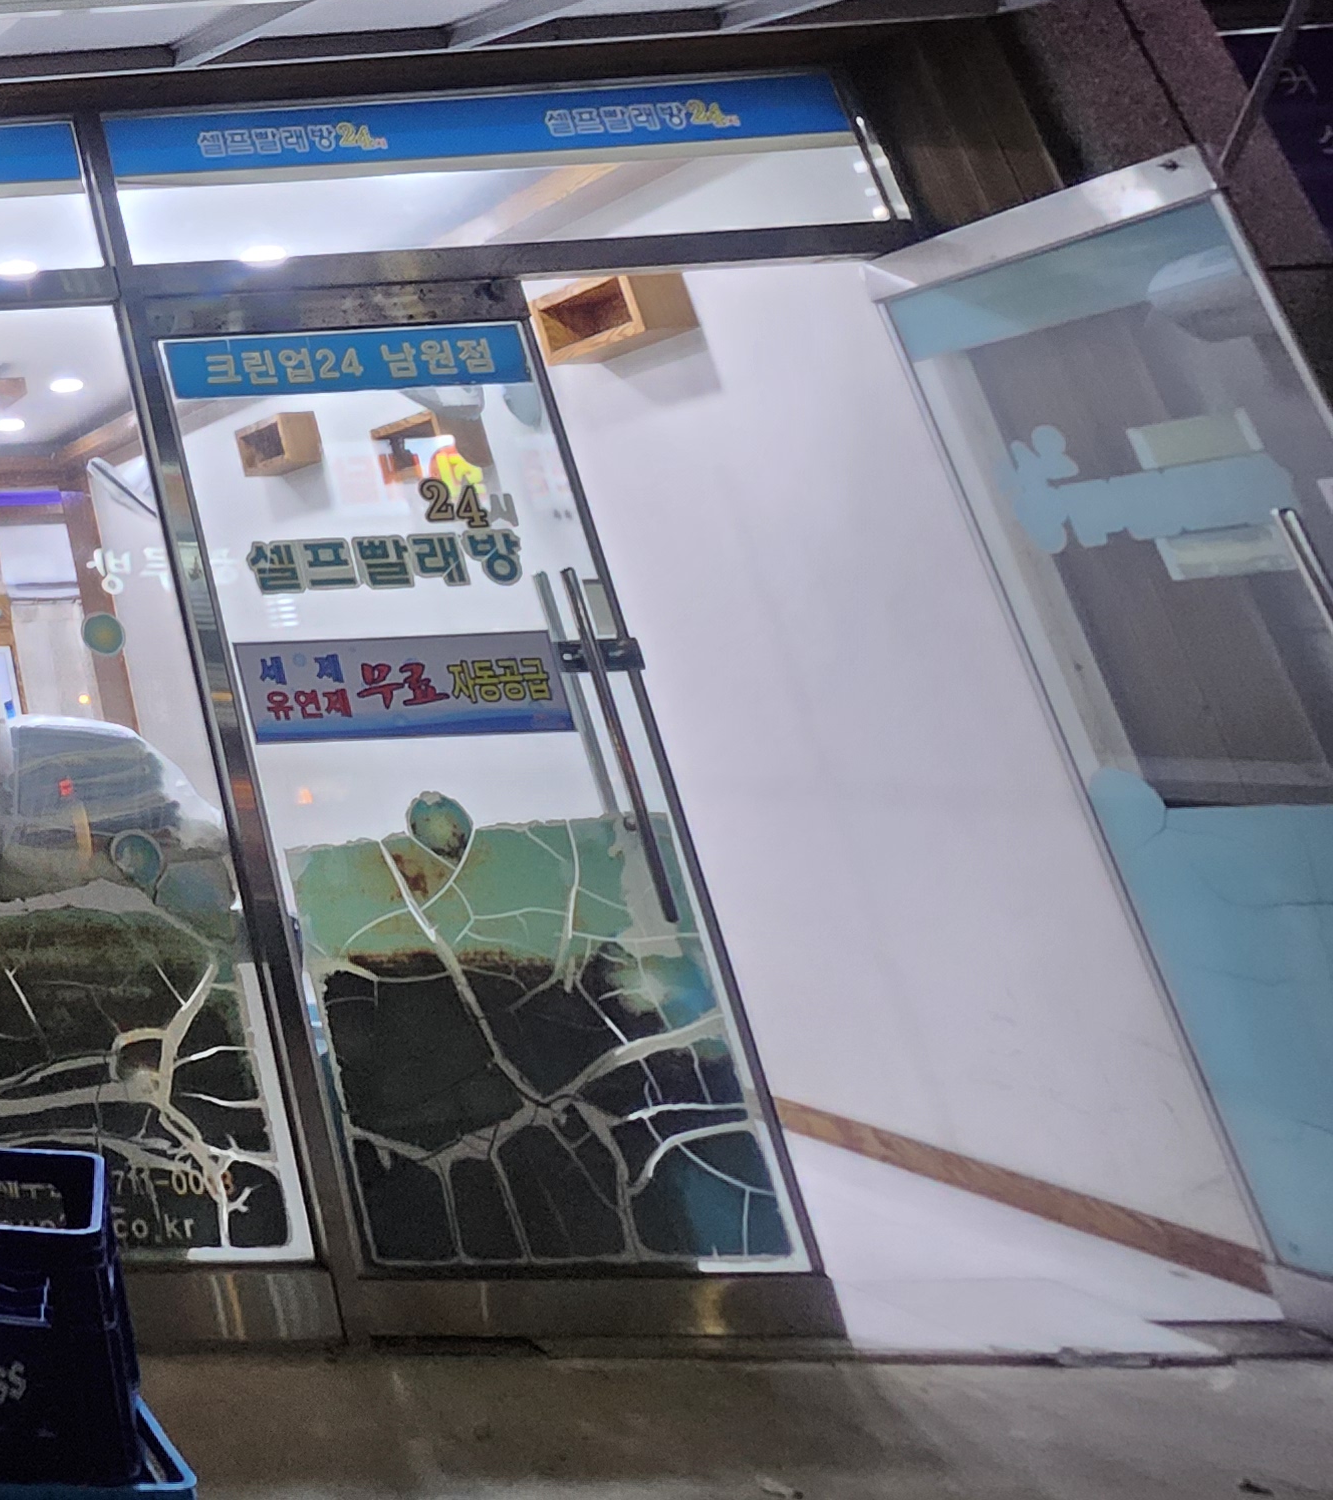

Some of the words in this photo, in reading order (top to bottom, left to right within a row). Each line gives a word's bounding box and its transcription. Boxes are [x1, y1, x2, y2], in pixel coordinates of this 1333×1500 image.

[381, 337, 497, 379] 남원점
[246, 529, 523, 595] 셀프빨래방
[266, 687, 354, 722] 유연제
[356, 662, 450, 710] 무료
[447, 657, 552, 704] 자동공급
